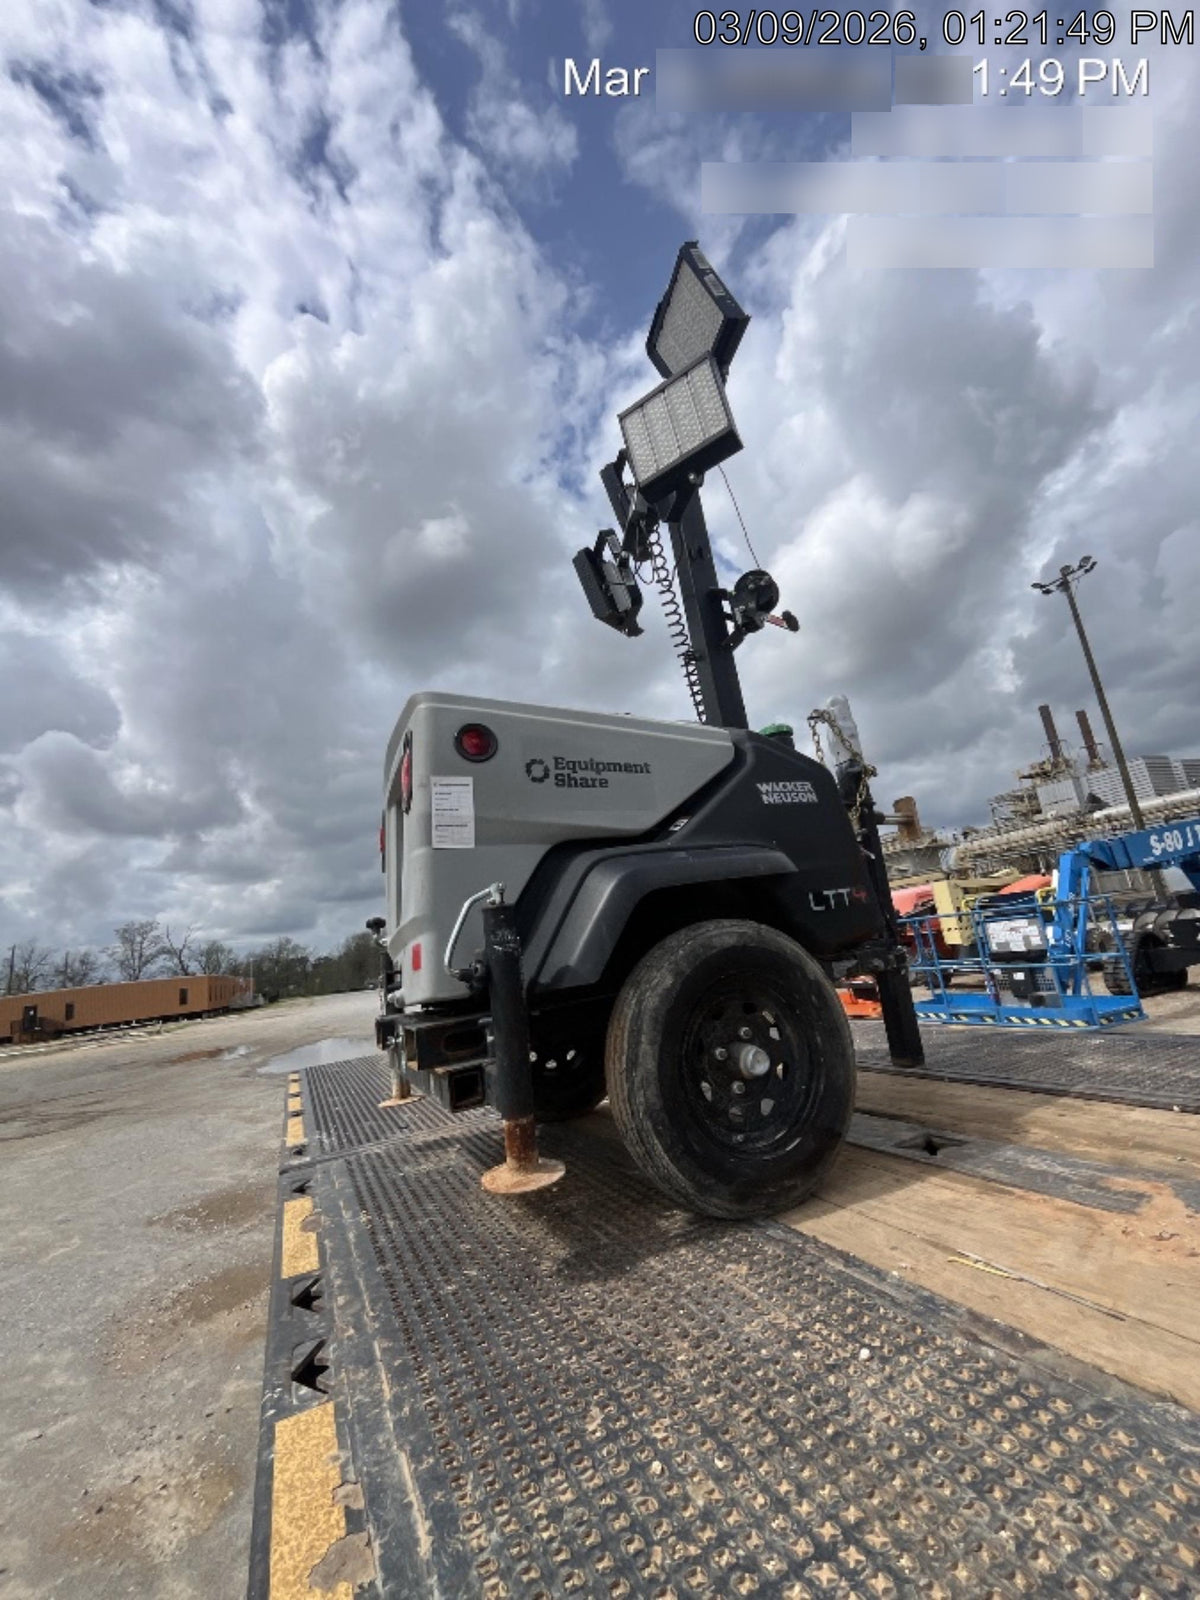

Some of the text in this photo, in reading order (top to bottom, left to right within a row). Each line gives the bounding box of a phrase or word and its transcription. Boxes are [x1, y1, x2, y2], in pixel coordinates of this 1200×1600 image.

[553, 756, 651, 775] Equipment
[554, 773, 609, 788] Share
[756, 781, 815, 793] WACKER
[761, 792, 819, 804] NEUSON
